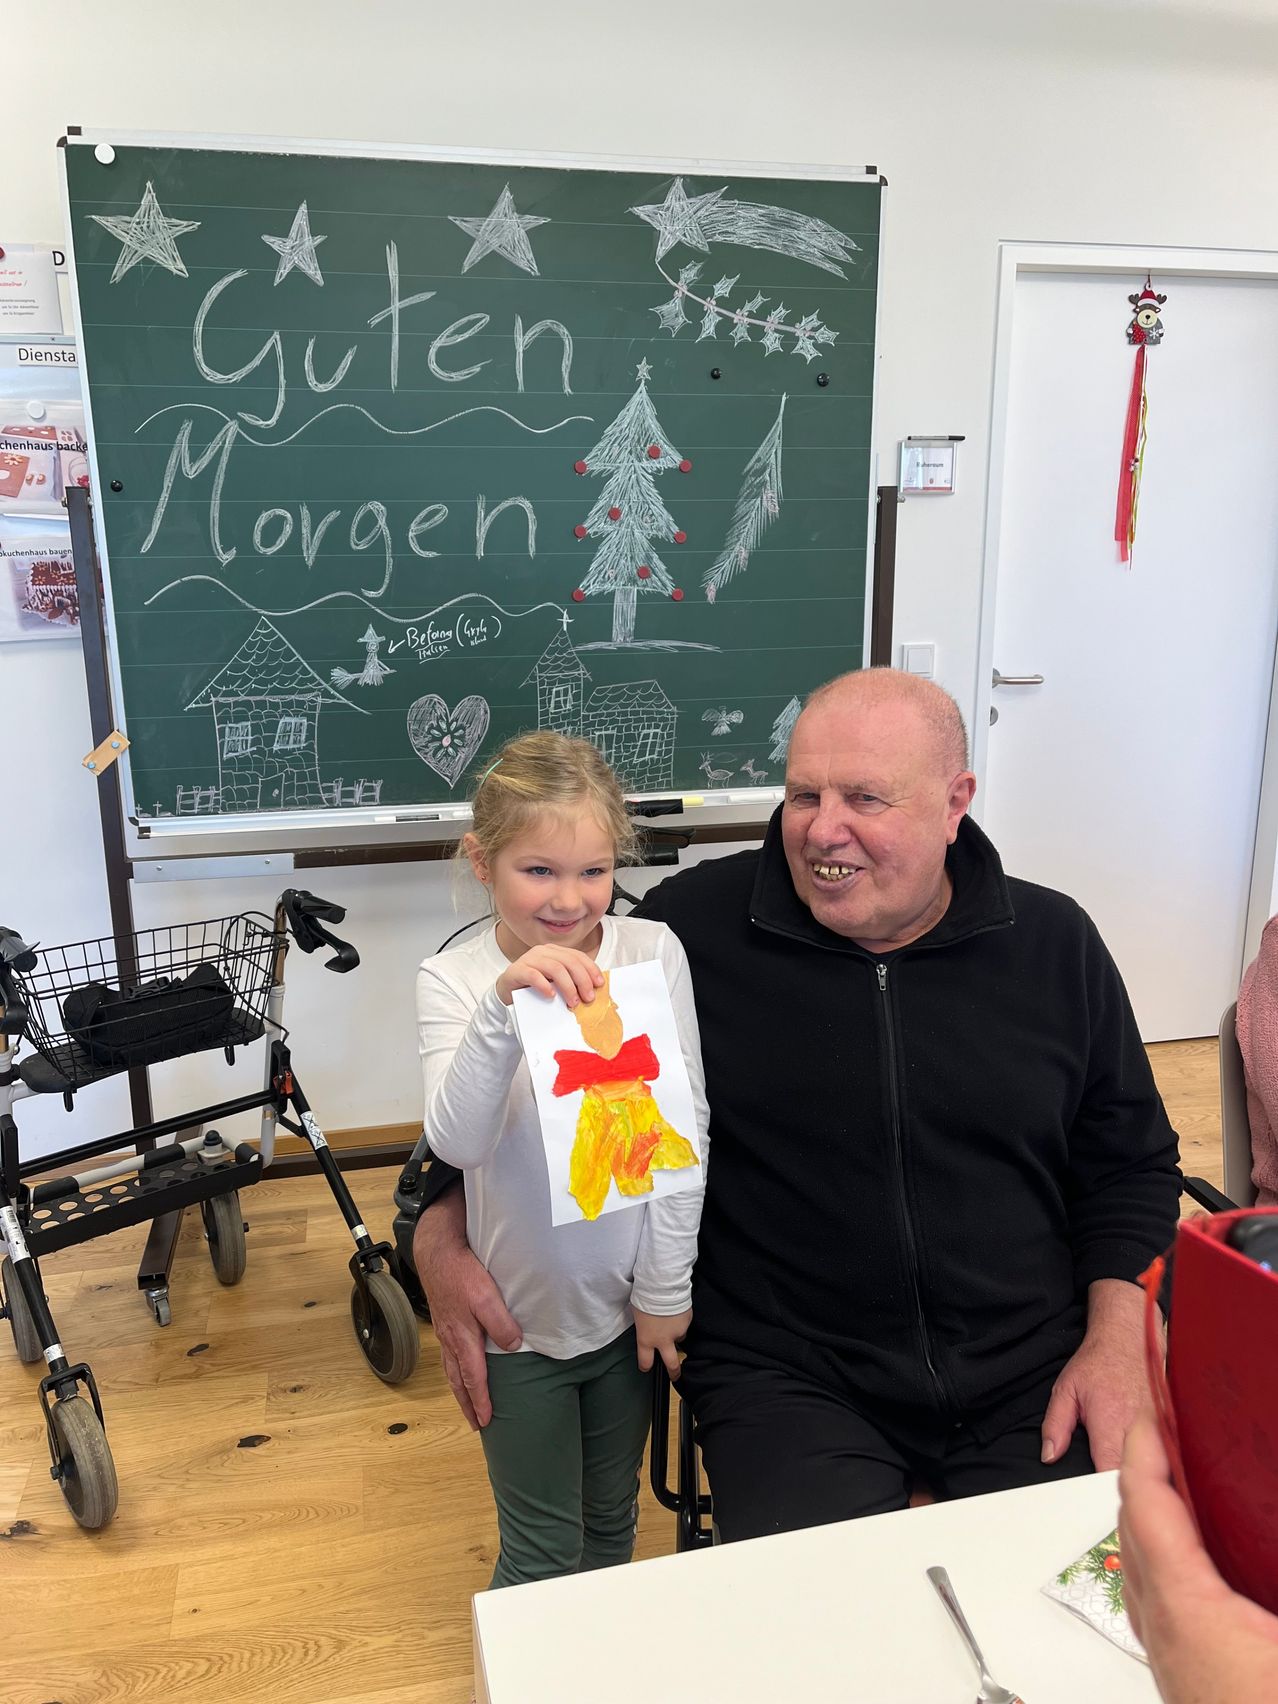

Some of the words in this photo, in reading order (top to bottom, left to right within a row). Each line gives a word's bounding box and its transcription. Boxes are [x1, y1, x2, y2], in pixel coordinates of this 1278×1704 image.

[18, 347, 78, 364] Diensta
[193, 239, 574, 428] Guten
[140, 419, 537, 598] Morgen
